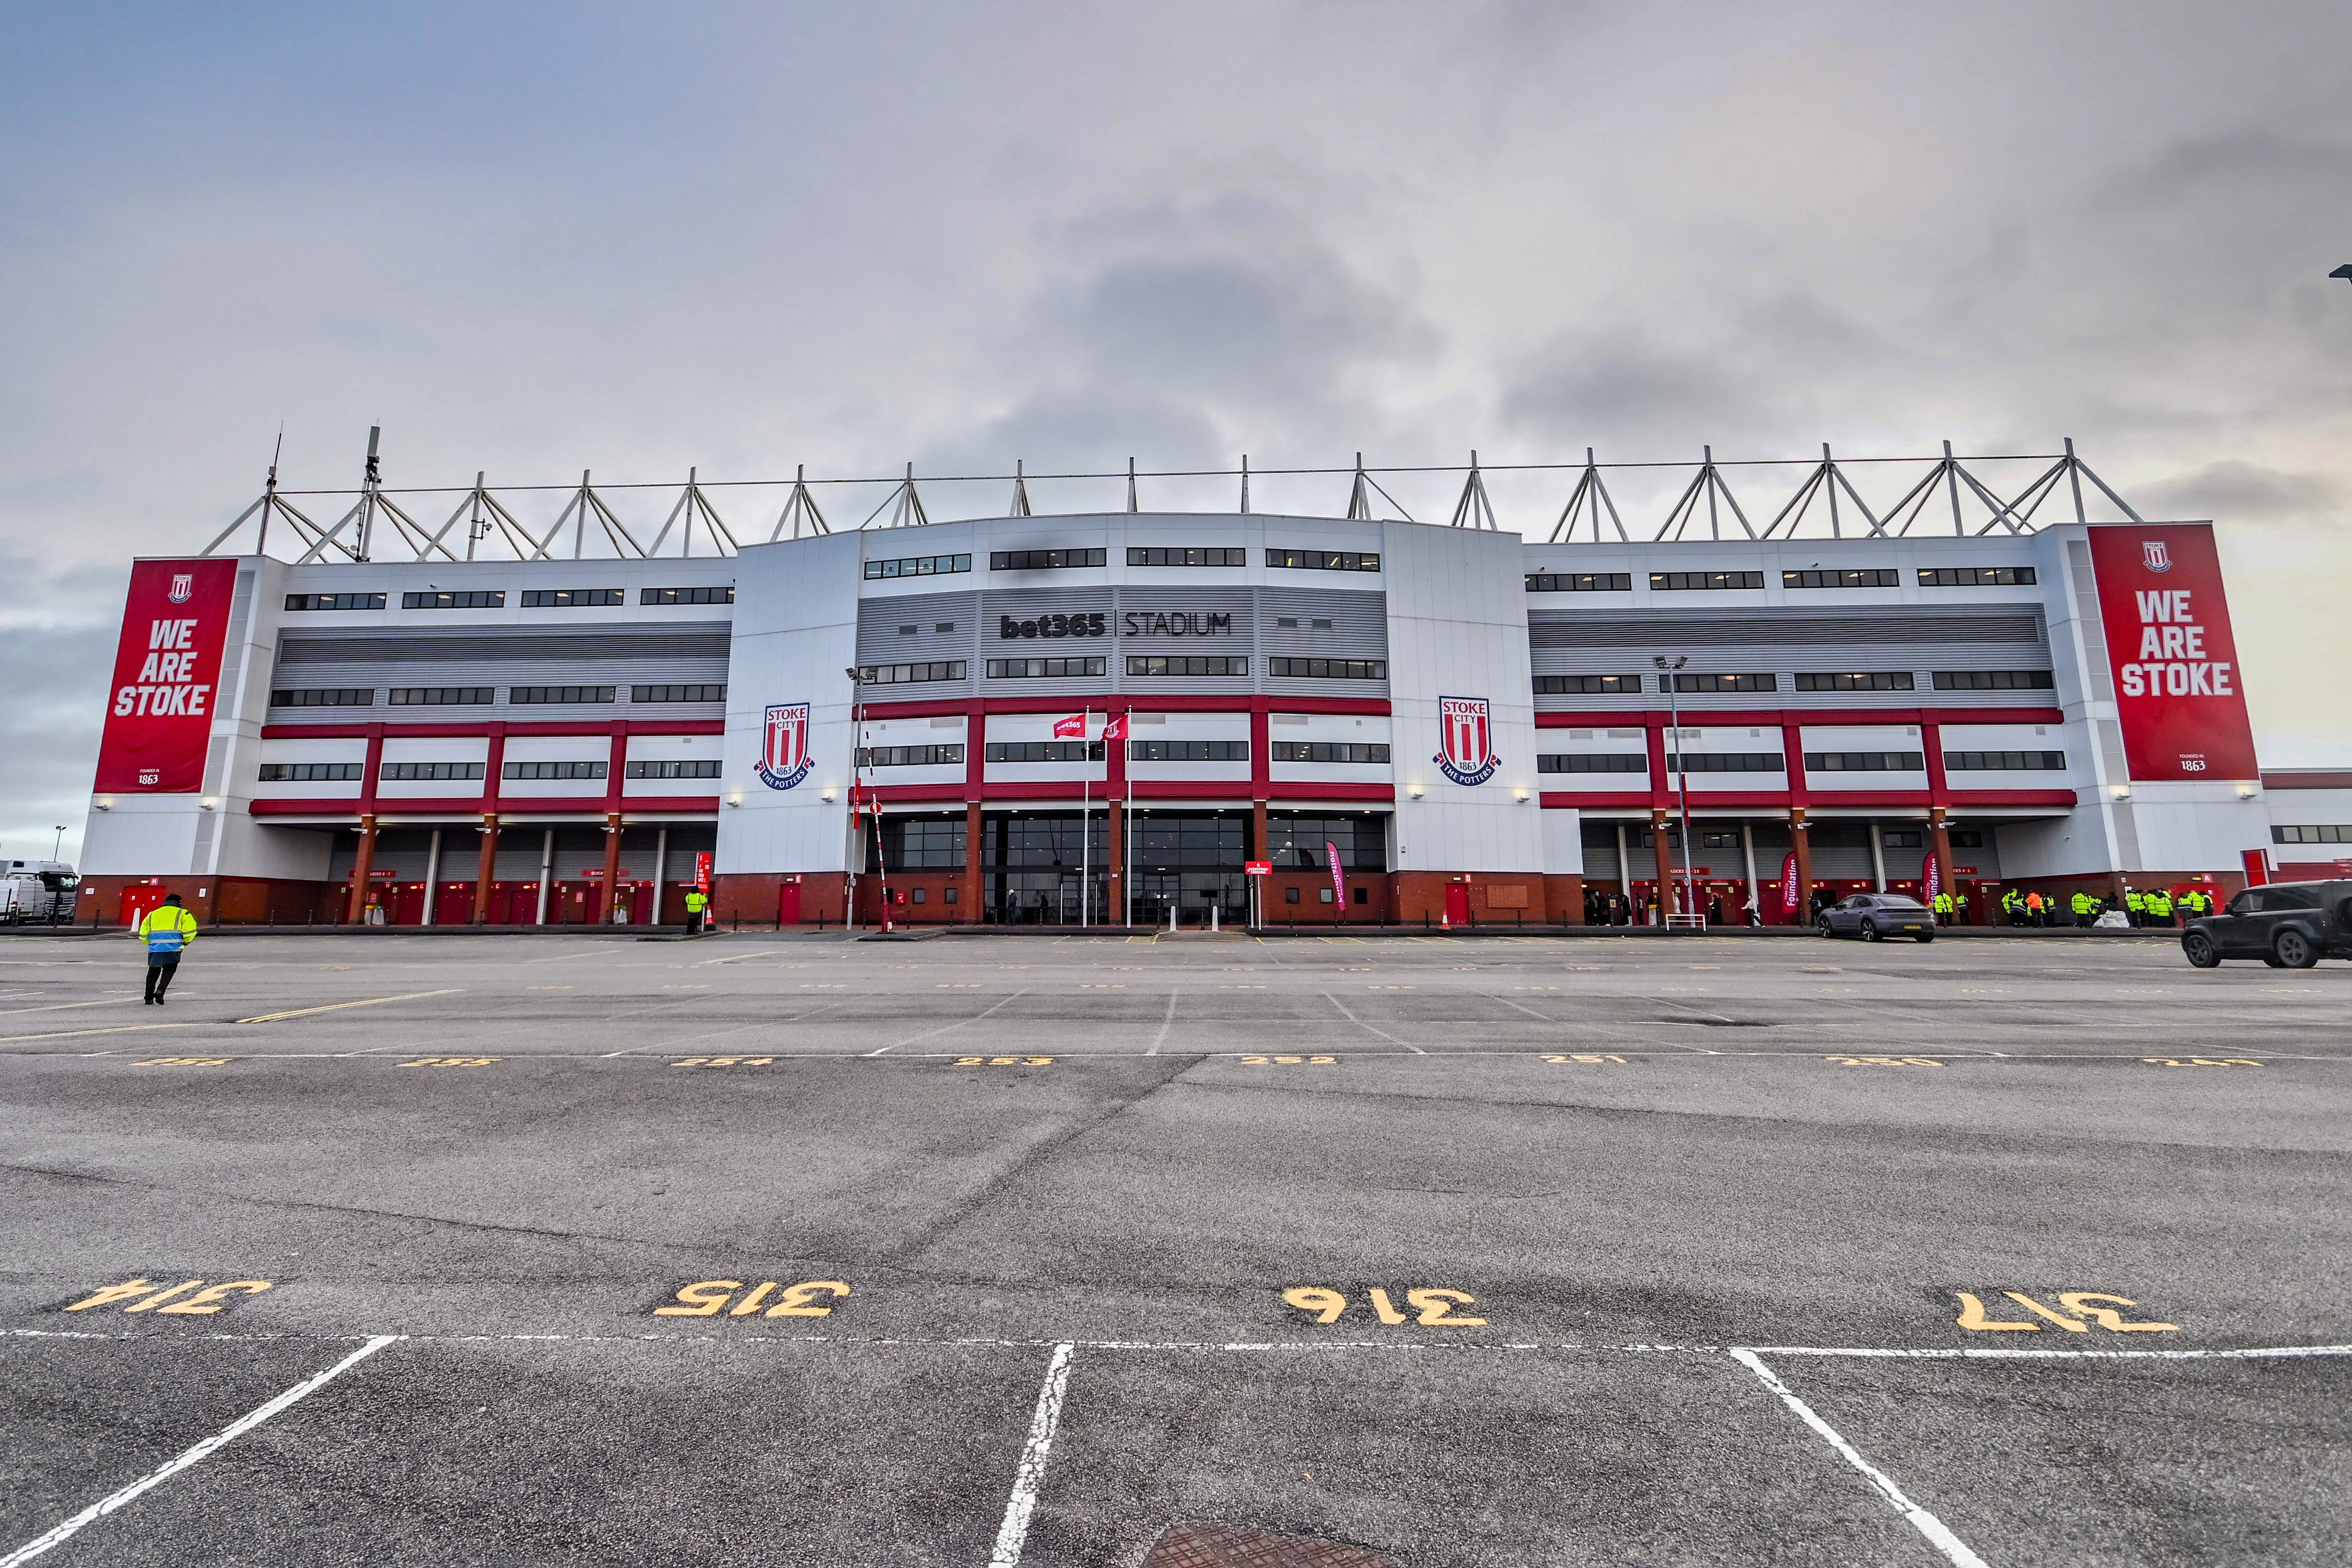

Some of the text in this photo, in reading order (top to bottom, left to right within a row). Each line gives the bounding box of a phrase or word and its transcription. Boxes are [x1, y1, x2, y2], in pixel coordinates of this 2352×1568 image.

[2135, 590, 2193, 623] WE
[1001, 612, 1231, 638] bet365 STADIUM
[149, 619, 198, 650] WE
[2139, 626, 2206, 660] ARE
[137, 652, 198, 683] ARE
[2121, 662, 2233, 697] STOKE
[114, 685, 211, 716] STOKE
[1443, 701, 1486, 714] STOKE
[768, 708, 806, 721] STOKE
[1454, 714, 1476, 723] CITY
[776, 721, 796, 729] CITY
[776, 766, 792, 775] 1863
[1459, 762, 1477, 771] 1863
[2181, 760, 2206, 771] 1863
[139, 774, 158, 784] 1863
[762, 769, 805, 788] THE POTTERS
[1444, 764, 1492, 784] THE POTTERS
[128, 1058, 234, 1066] 256
[396, 1058, 504, 1067] 255
[670, 1057, 773, 1067] 254
[953, 1057, 1054, 1066] 253
[1241, 1056, 1337, 1065] 252
[1539, 1055, 1627, 1063] 251
[1825, 1057, 1944, 1067] 250
[64, 1279, 273, 1314] 314
[653, 1280, 850, 1318] 315
[1281, 1286, 1488, 1326] 316
[1955, 1291, 2181, 1333] 317
